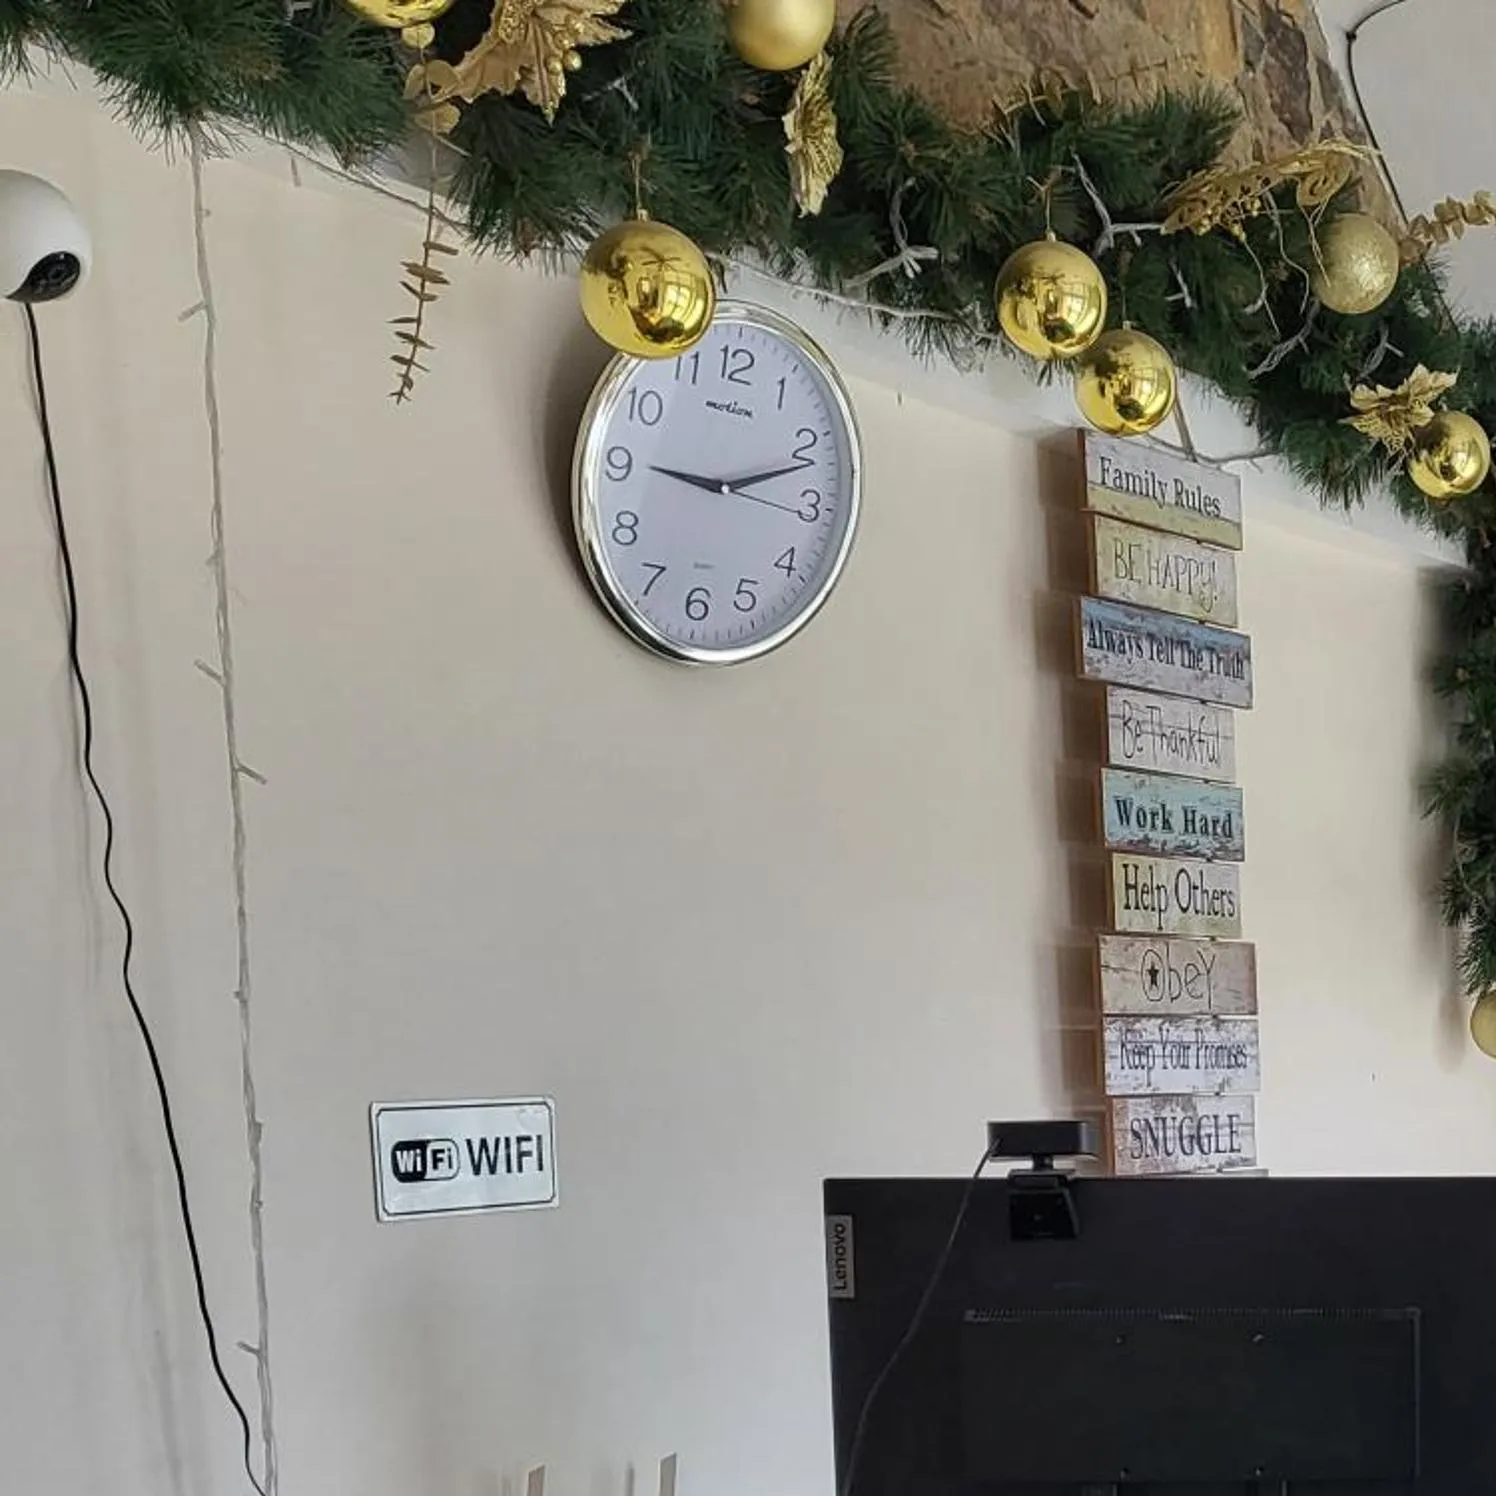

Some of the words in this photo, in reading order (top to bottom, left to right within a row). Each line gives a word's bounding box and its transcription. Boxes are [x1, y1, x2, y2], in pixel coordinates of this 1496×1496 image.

[674, 350, 700, 385] 11
[720, 344, 755, 385] 12
[628, 387, 663, 426] 10
[705, 400, 753, 418] motion
[776, 376, 787, 410] 1
[605, 446, 633, 482] 9
[791, 428, 818, 465] 2
[798, 489, 821, 523] 3
[1100, 456, 1168, 509] Family
[1173, 478, 1222, 518] Rules
[611, 510, 639, 546] 8
[641, 561, 668, 597] 7
[773, 546, 797, 578] 4
[1113, 537, 1142, 586] BE
[684, 586, 712, 621] 6
[732, 577, 760, 613] 5
[1086, 620, 1144, 665] Always
[1148, 632, 1177, 664] Tell
[1178, 638, 1204, 672] The
[1208, 643, 1246, 682] Truth
[1121, 699, 1144, 759] Be
[1146, 705, 1221, 767] Thankful
[1113, 795, 1174, 833] Work
[1182, 804, 1234, 839] Hard
[1122, 863, 1169, 931] Help
[1173, 868, 1236, 918] Others
[1119, 1028, 1157, 1087] Keep
[1158, 1026, 1192, 1071] Your
[1194, 1028, 1248, 1071] Promises
[464, 1133, 544, 1176] WIFI
[1129, 1114, 1242, 1160] SNUGGLE
[834, 1225, 846, 1290] Lenovo
